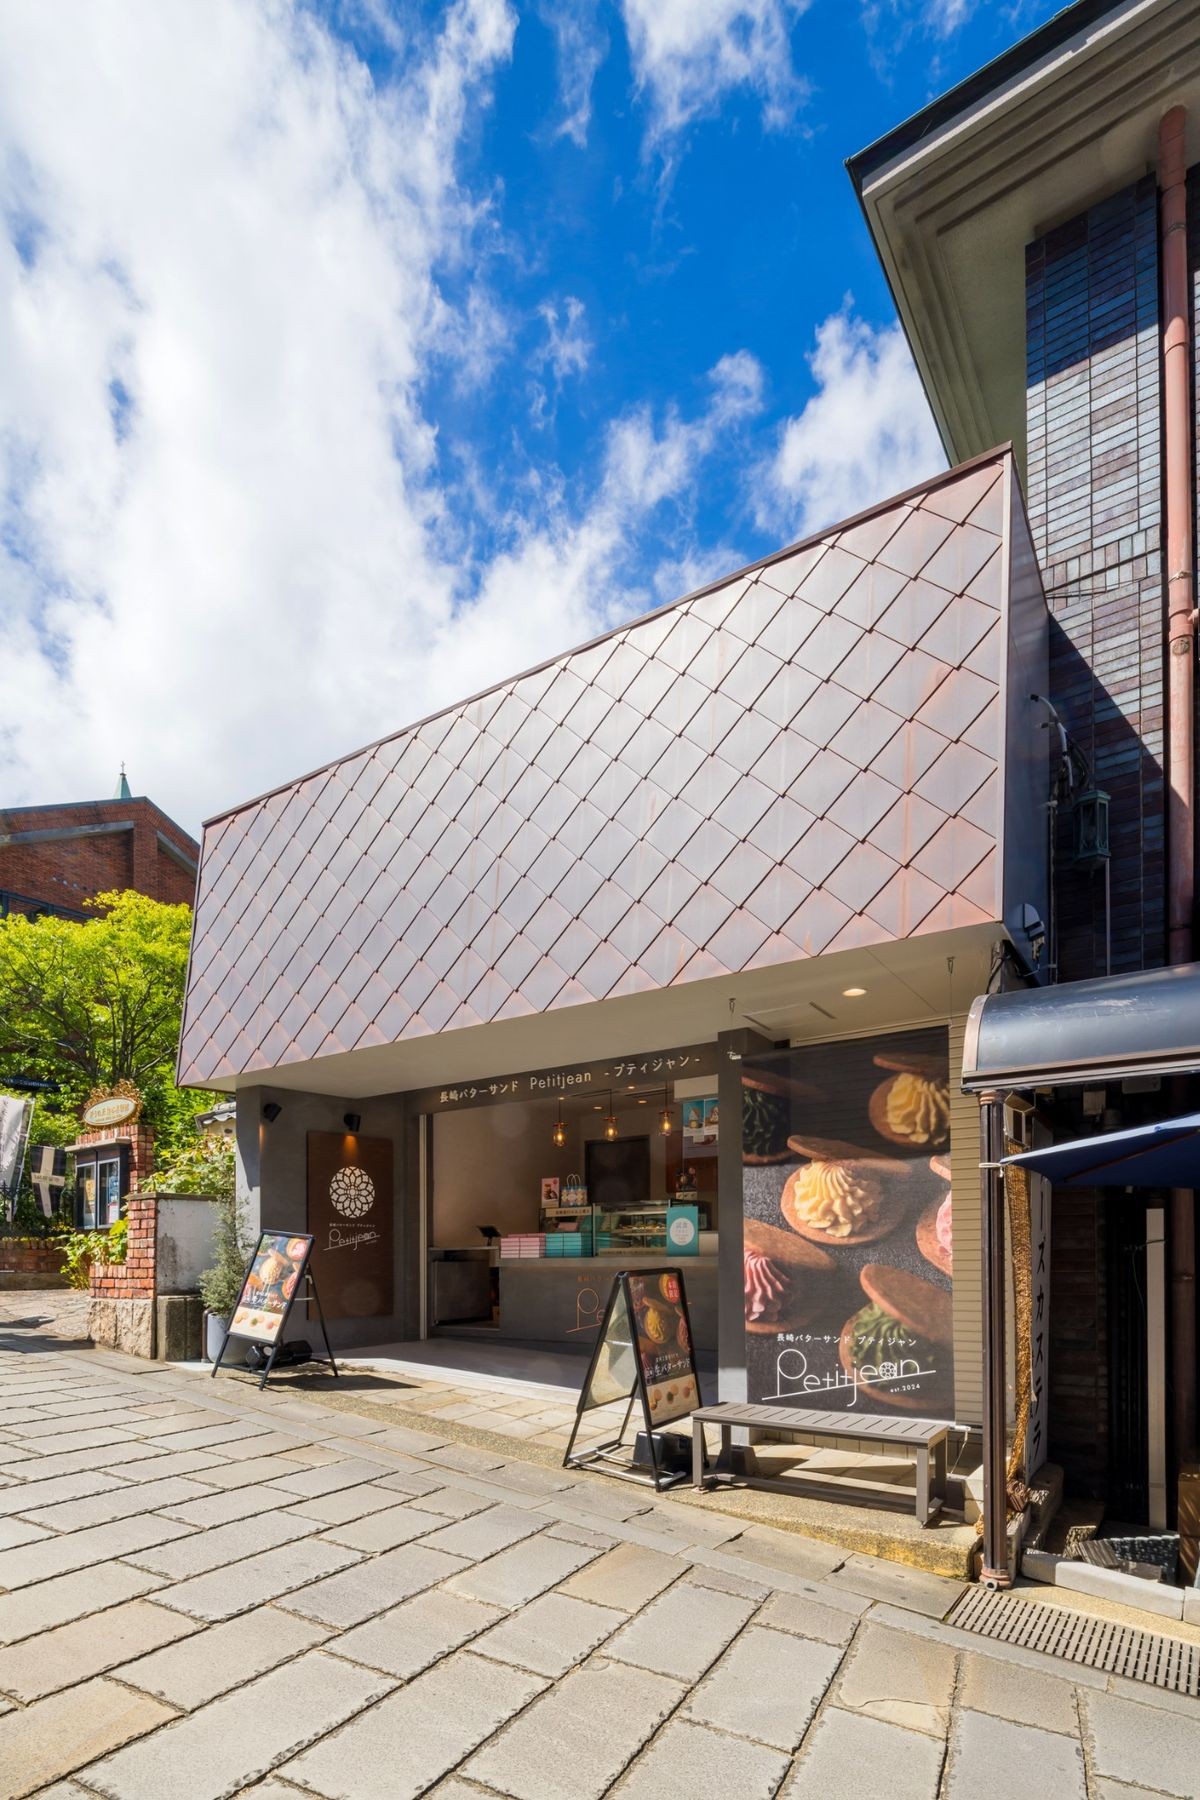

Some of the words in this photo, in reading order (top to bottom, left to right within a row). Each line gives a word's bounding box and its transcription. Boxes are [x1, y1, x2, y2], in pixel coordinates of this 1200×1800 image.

[440, 1080, 518, 1103] 長崎バターサンド
[530, 1072, 592, 1090] Petitjean
[1033, 1175, 1046, 1462] ーズカステラ
[777, 1333, 850, 1345] 長崎バターサンド
[858, 1335, 917, 1347] プティジャン
[776, 1348, 921, 1407] Petitjean
